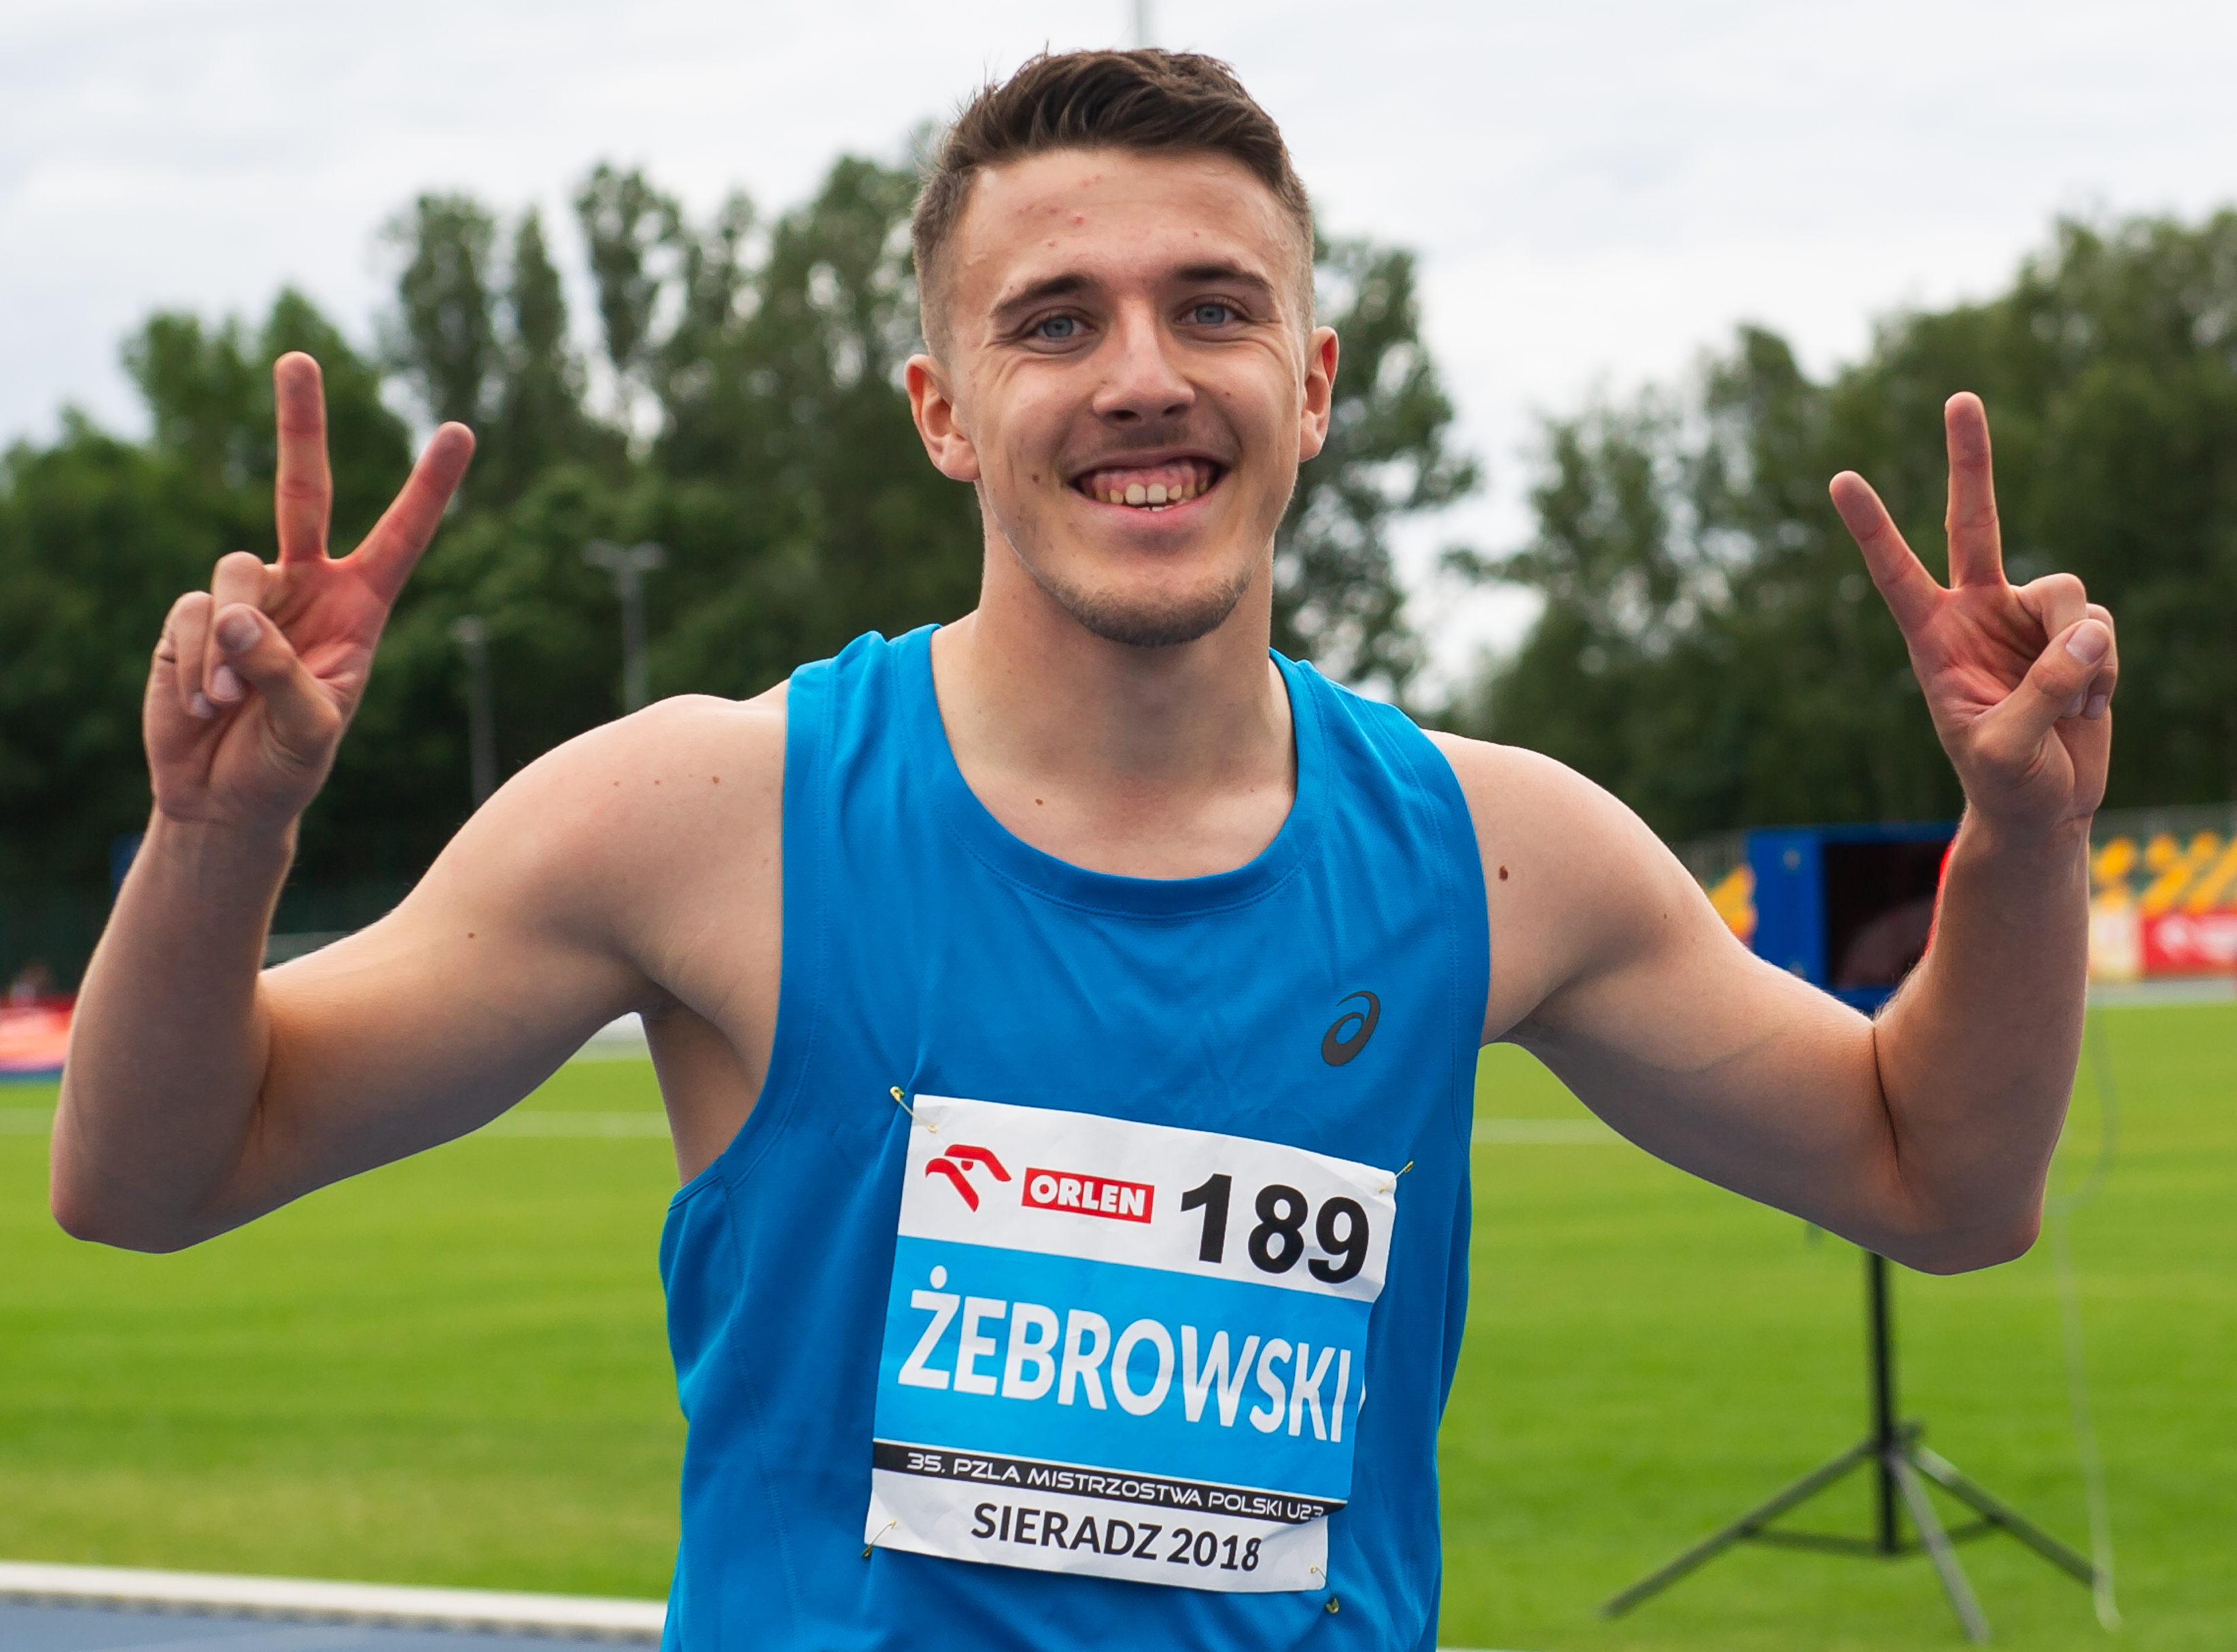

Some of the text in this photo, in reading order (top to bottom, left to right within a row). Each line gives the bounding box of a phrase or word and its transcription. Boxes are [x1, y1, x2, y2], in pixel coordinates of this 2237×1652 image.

[1029, 1174, 1146, 1217] ORLEN
[1180, 1173, 1370, 1284] 189
[897, 1265, 1351, 1443] ŻEBROWSKI
[906, 1452, 946, 1473] 35.
[953, 1458, 1021, 1483] PZLA
[1026, 1467, 1202, 1507] MISTRZOSTWA
[1208, 1491, 1282, 1517] POLSKI
[971, 1502, 1262, 1572] SIERADZ 2018
